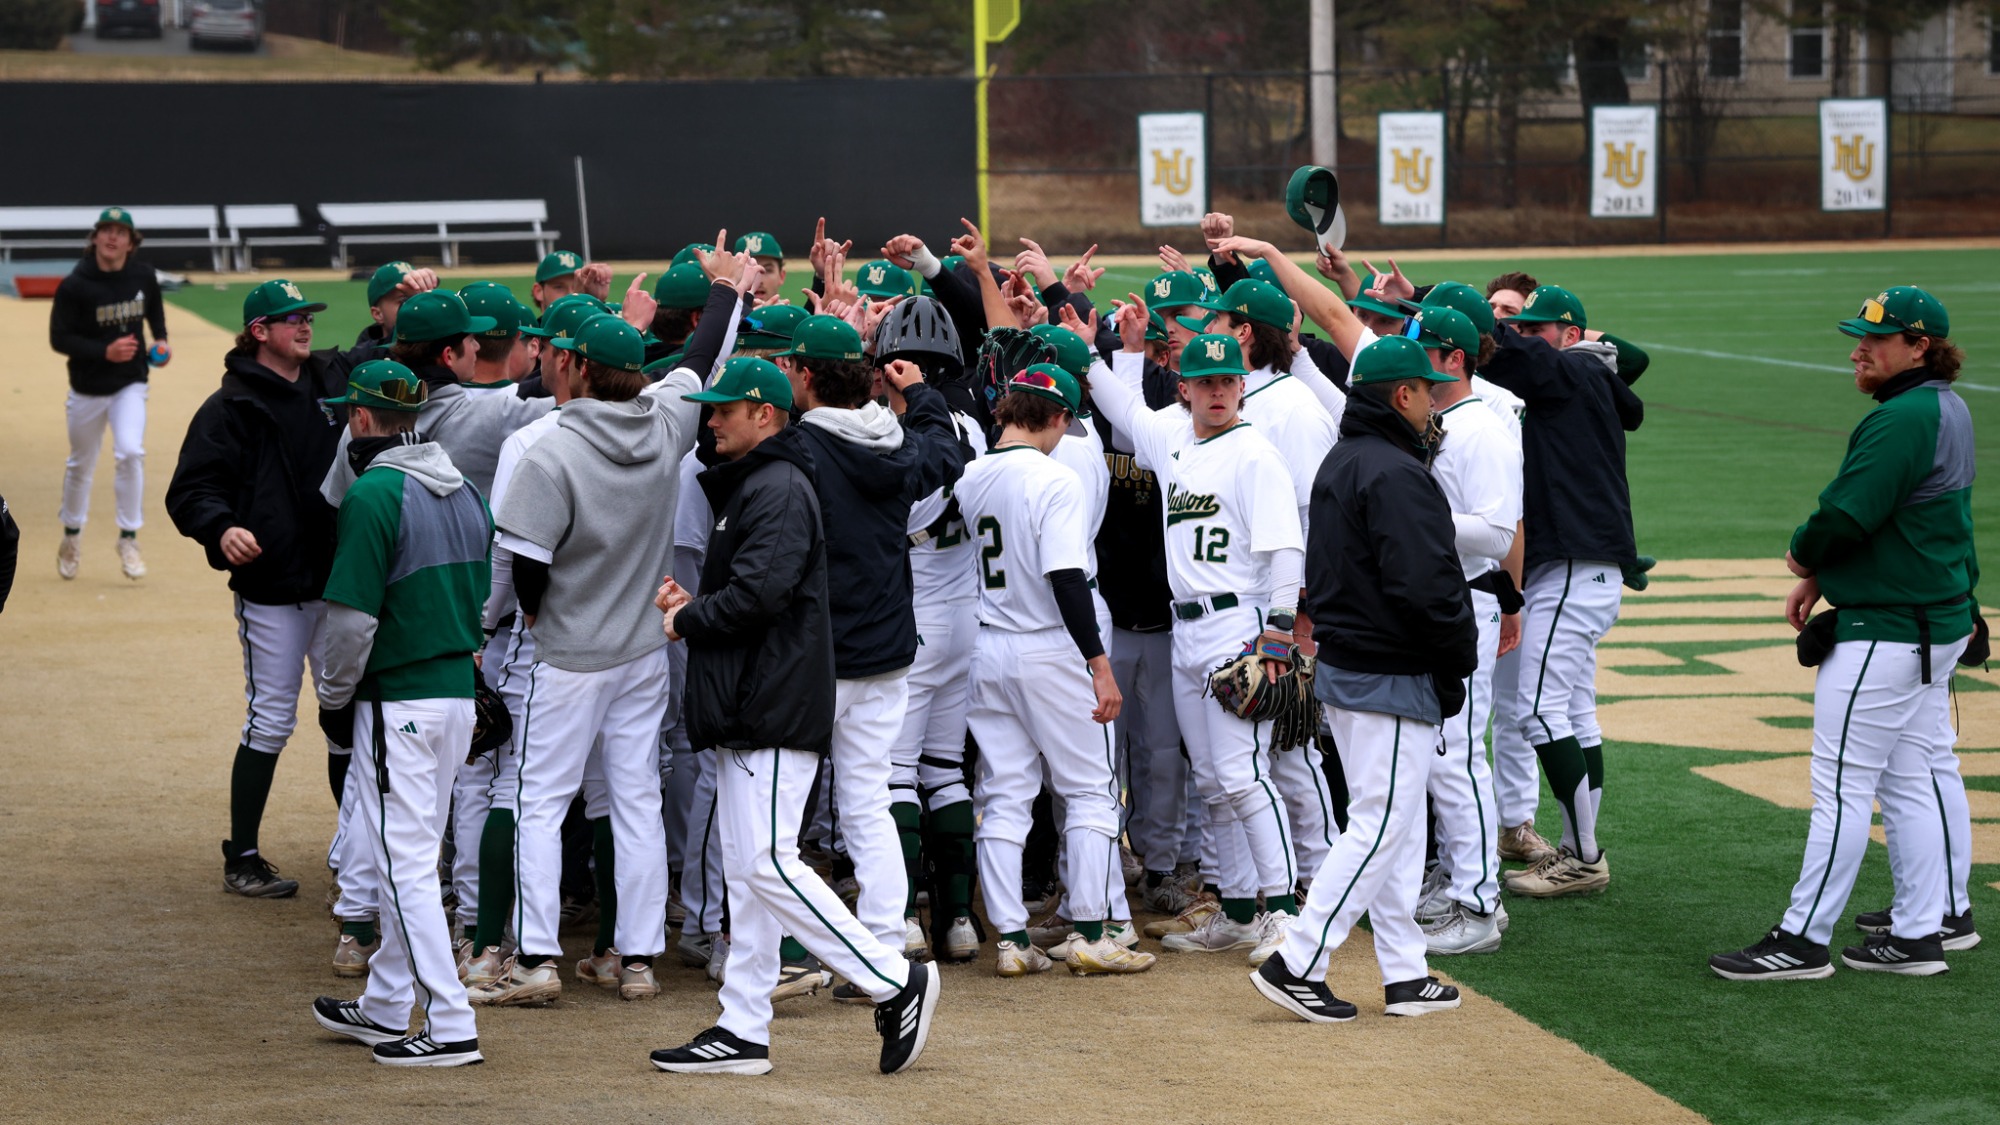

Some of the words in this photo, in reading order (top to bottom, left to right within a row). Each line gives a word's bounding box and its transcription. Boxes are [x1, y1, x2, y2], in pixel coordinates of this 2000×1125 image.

[1392, 203, 1430, 218] 2011
[1603, 196, 1644, 212] 2013
[977, 515, 1007, 590] 2
[1193, 525, 1230, 563] 12
